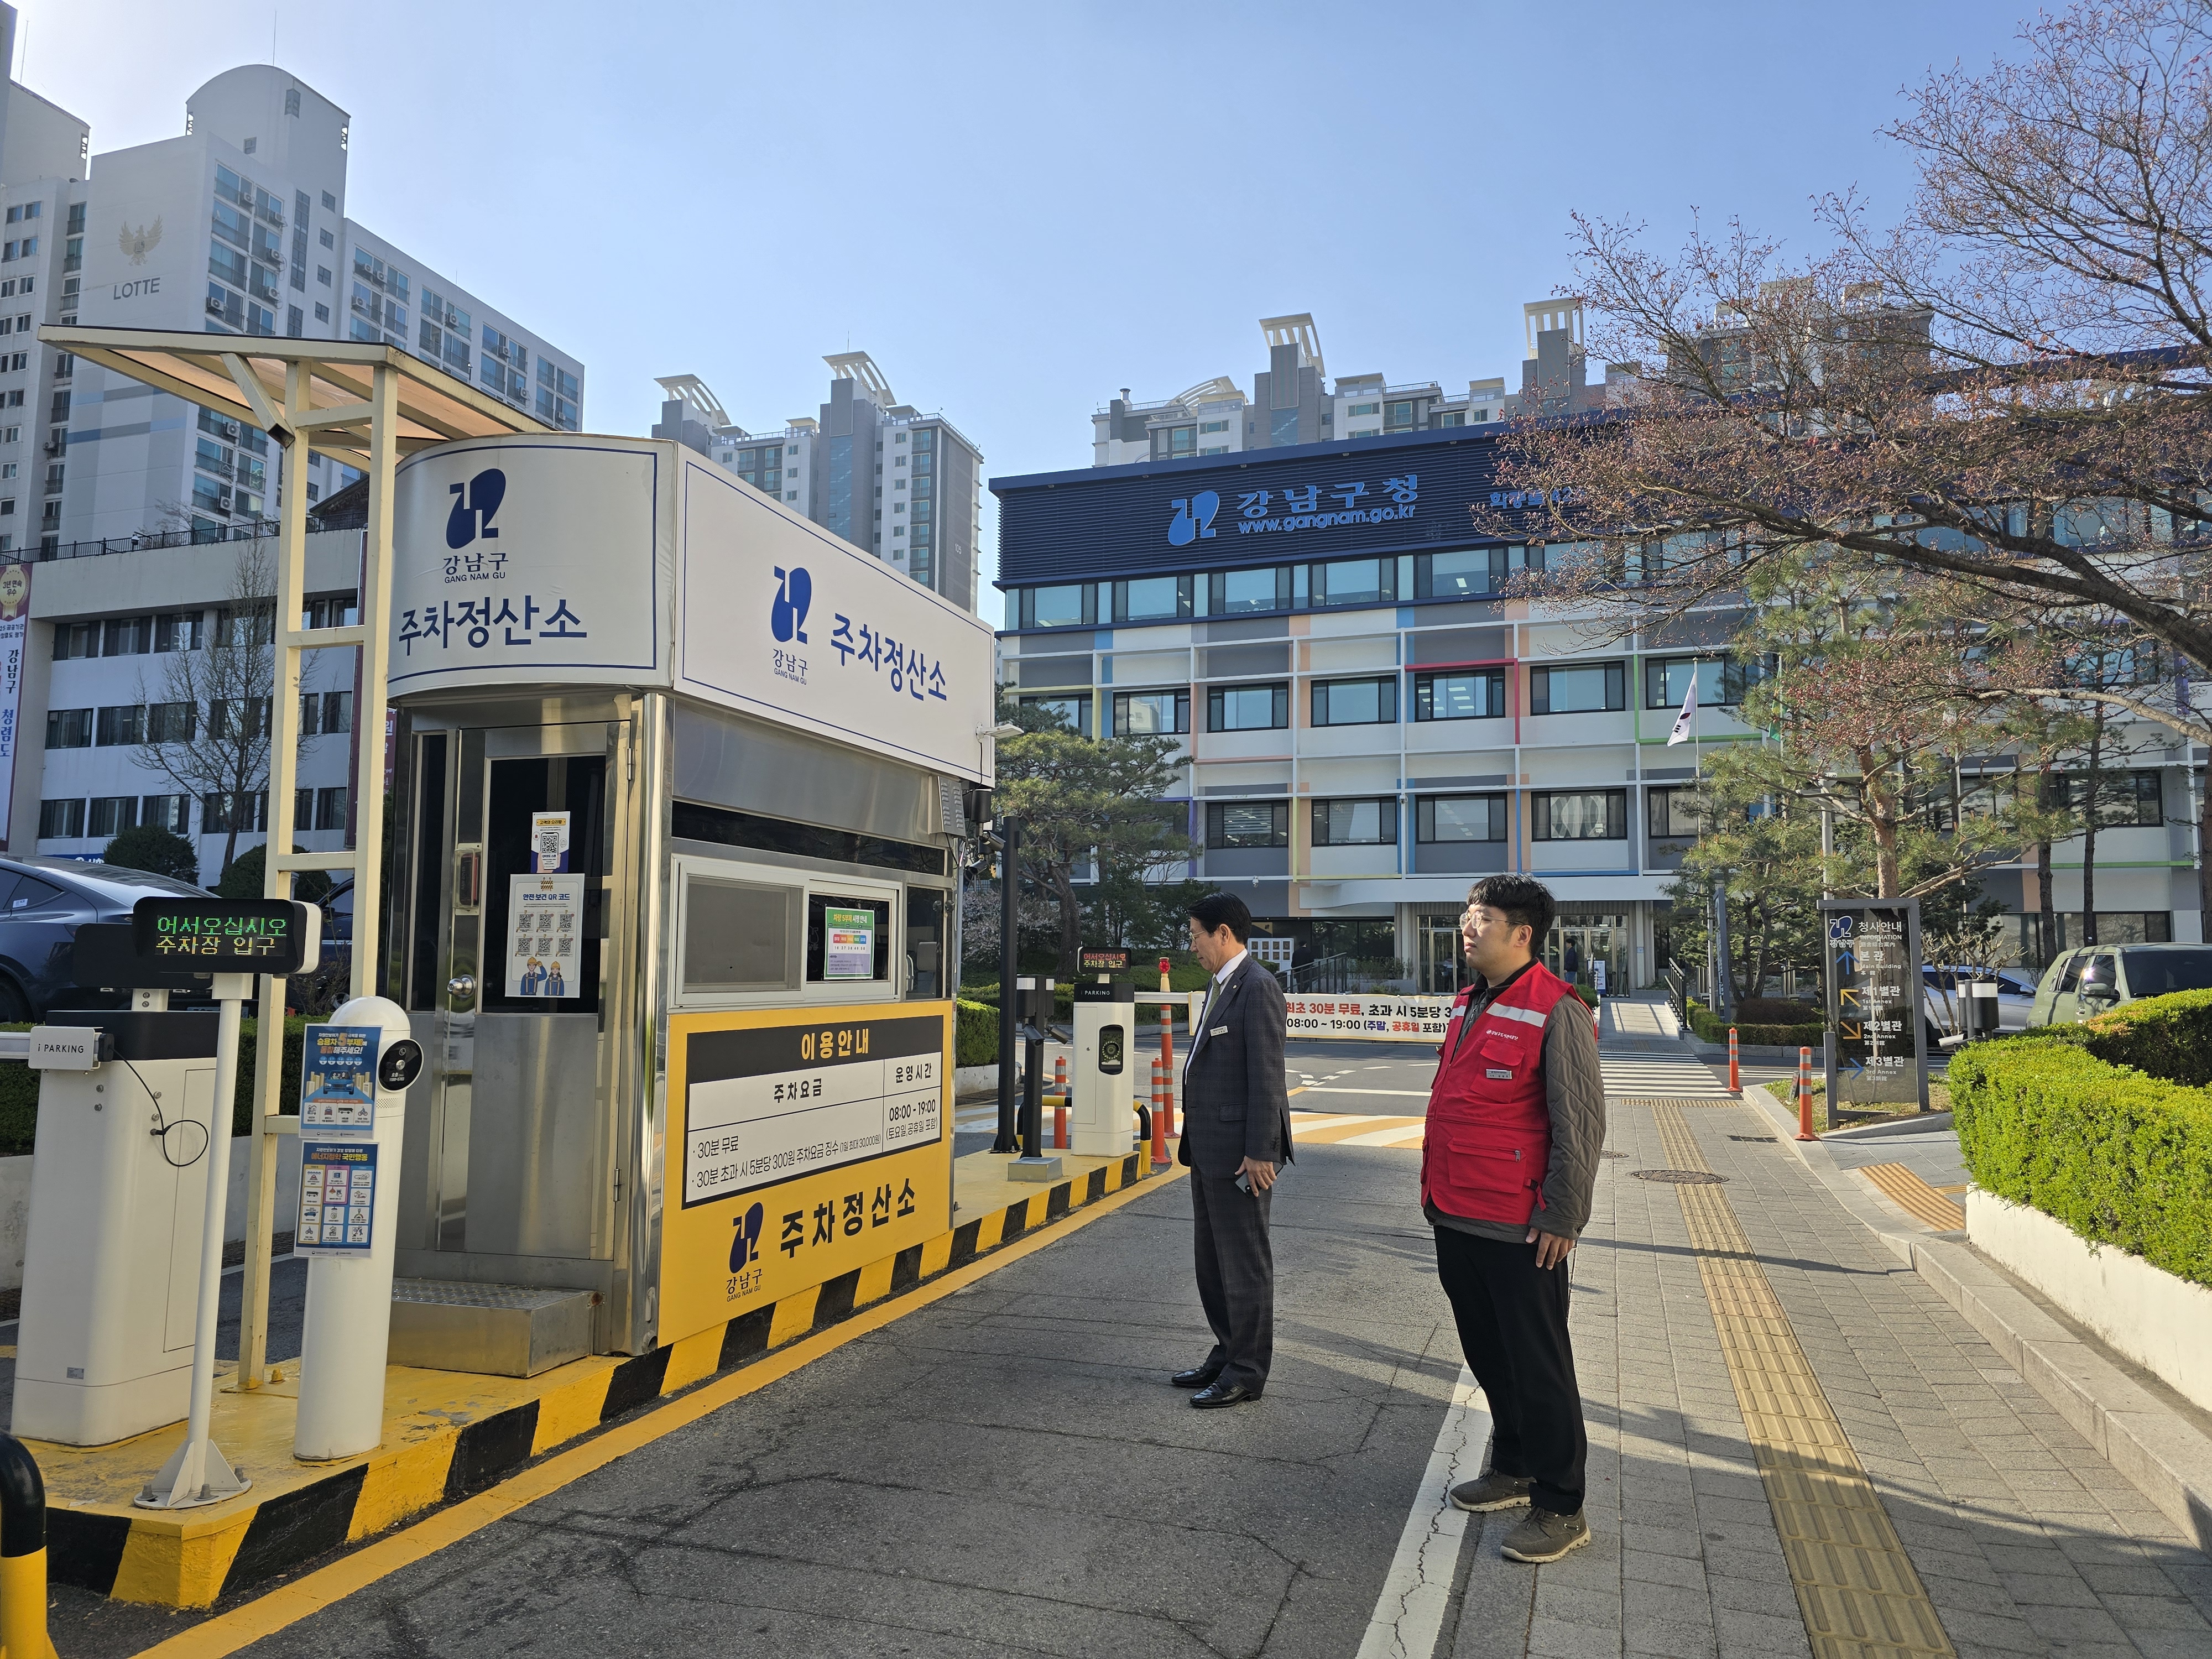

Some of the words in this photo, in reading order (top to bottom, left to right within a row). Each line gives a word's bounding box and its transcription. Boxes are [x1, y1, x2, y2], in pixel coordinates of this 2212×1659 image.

[113, 277, 160, 300] LOTTE
[1238, 504, 1416, 534] www.gangnam.go.kr
[443, 553, 508, 575] 강남구
[445, 575, 467, 583] GANG
[399, 595, 587, 656] 주차정산소
[773, 649, 808, 676] 강남구
[831, 613, 947, 701] 주차정산소
[6, 649, 19, 694] 강남구
[774, 667, 787, 678] GANG
[789, 672, 799, 682] NAM
[800, 677, 807, 685] GU
[158, 916, 286, 936] 어서오십시오
[1858, 921, 1902, 932] 청사안내
[156, 936, 221, 955] 주차장
[233, 937, 275, 955] 입구
[1829, 940, 1855, 948] 강남구
[1861, 986, 1901, 996] 제1별관
[1286, 1002, 1306, 1014] 최초
[1309, 1003, 1335, 1015] 30분
[1338, 1003, 1364, 1016] 무료,
[1368, 1004, 1392, 1016] 초과
[1396, 1005, 1407, 1017] 시
[1410, 1006, 1441, 1018] 5분당
[1286, 1018, 1318, 1029] 08:00
[1330, 1019, 1360, 1030] 19:00
[1364, 1020, 1389, 1032] (주말,
[1392, 1020, 1420, 1032] 공휴일
[1423, 1022, 1449, 1033] 포함)
[1863, 1021, 1902, 1031] 제2별관
[44, 1044, 84, 1053] PARKING
[801, 1028, 869, 1060] 이용안내
[1865, 1056, 1905, 1067] 제3별관
[896, 1063, 932, 1083] 운영시간
[774, 1078, 822, 1103] 주차요금
[889, 1104, 911, 1121] 08:00
[918, 1099, 936, 1115] 19:00
[926, 1117, 938, 1131] 포함)
[698, 1139, 719, 1159] 30분
[722, 1135, 739, 1154] 무료
[697, 1167, 718, 1188] 30분
[720, 1164, 738, 1182] 초과
[739, 1161, 748, 1177] 시
[750, 1156, 771, 1175] 5분당
[773, 1150, 795, 1170] 300원
[796, 1142, 823, 1164] 주차요금
[826, 1140, 839, 1156] 징수
[780, 1178, 916, 1259] 주차정산소
[726, 1269, 763, 1295] 강남구
[727, 1292, 740, 1302] GANG
[742, 1287, 753, 1296] NAM
